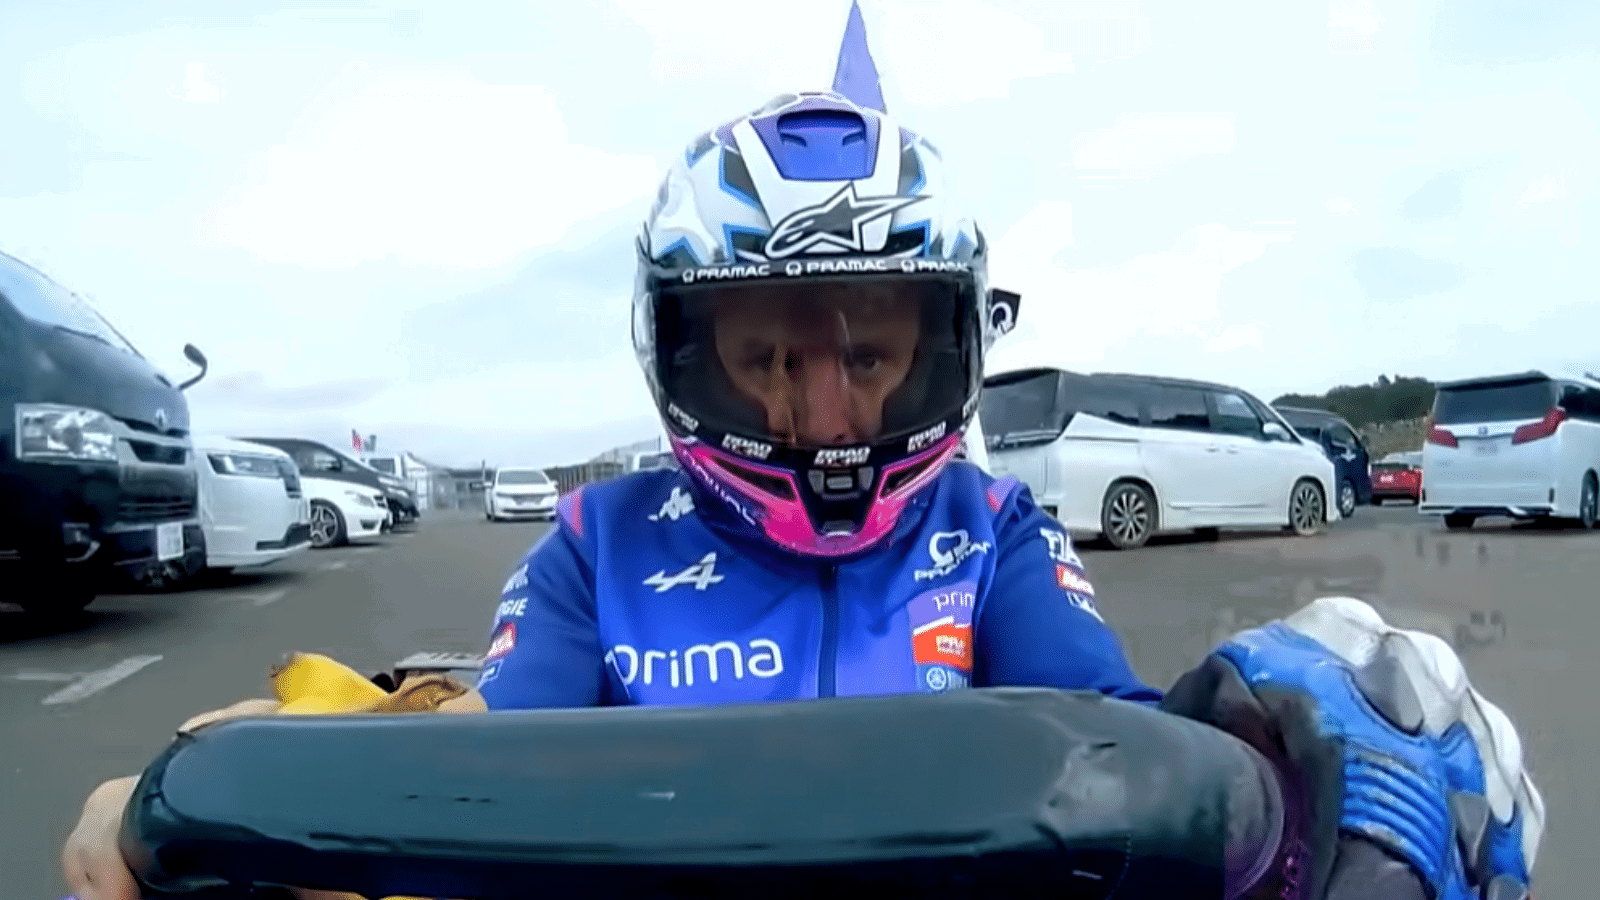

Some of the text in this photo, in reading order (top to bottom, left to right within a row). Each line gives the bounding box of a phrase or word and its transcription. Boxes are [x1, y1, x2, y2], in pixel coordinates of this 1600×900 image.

[697, 264, 771, 280] PRAMAC
[806, 258, 888, 273] PRAMAC
[605, 638, 784, 691] prima
